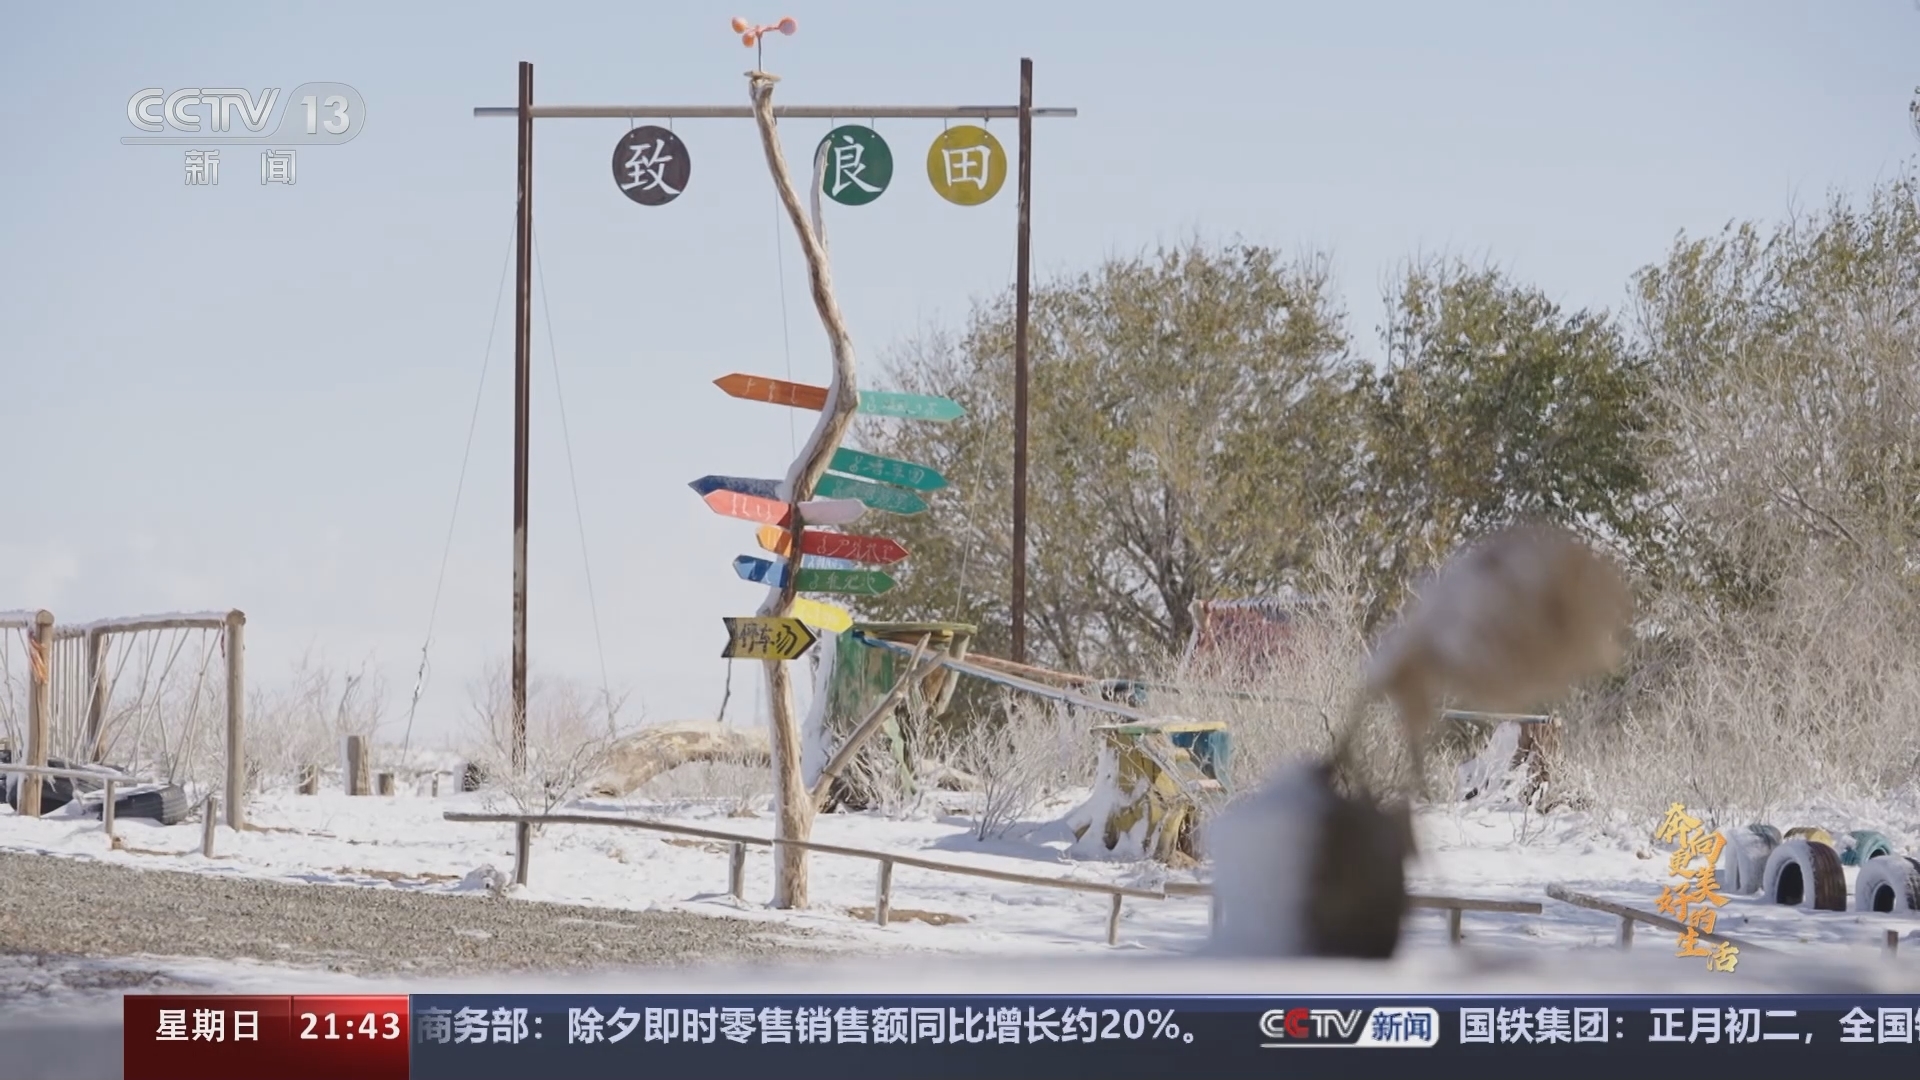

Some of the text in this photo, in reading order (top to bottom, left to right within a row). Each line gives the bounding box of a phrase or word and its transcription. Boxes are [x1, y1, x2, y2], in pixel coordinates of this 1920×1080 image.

[621, 135, 992, 196] 致 良 田
